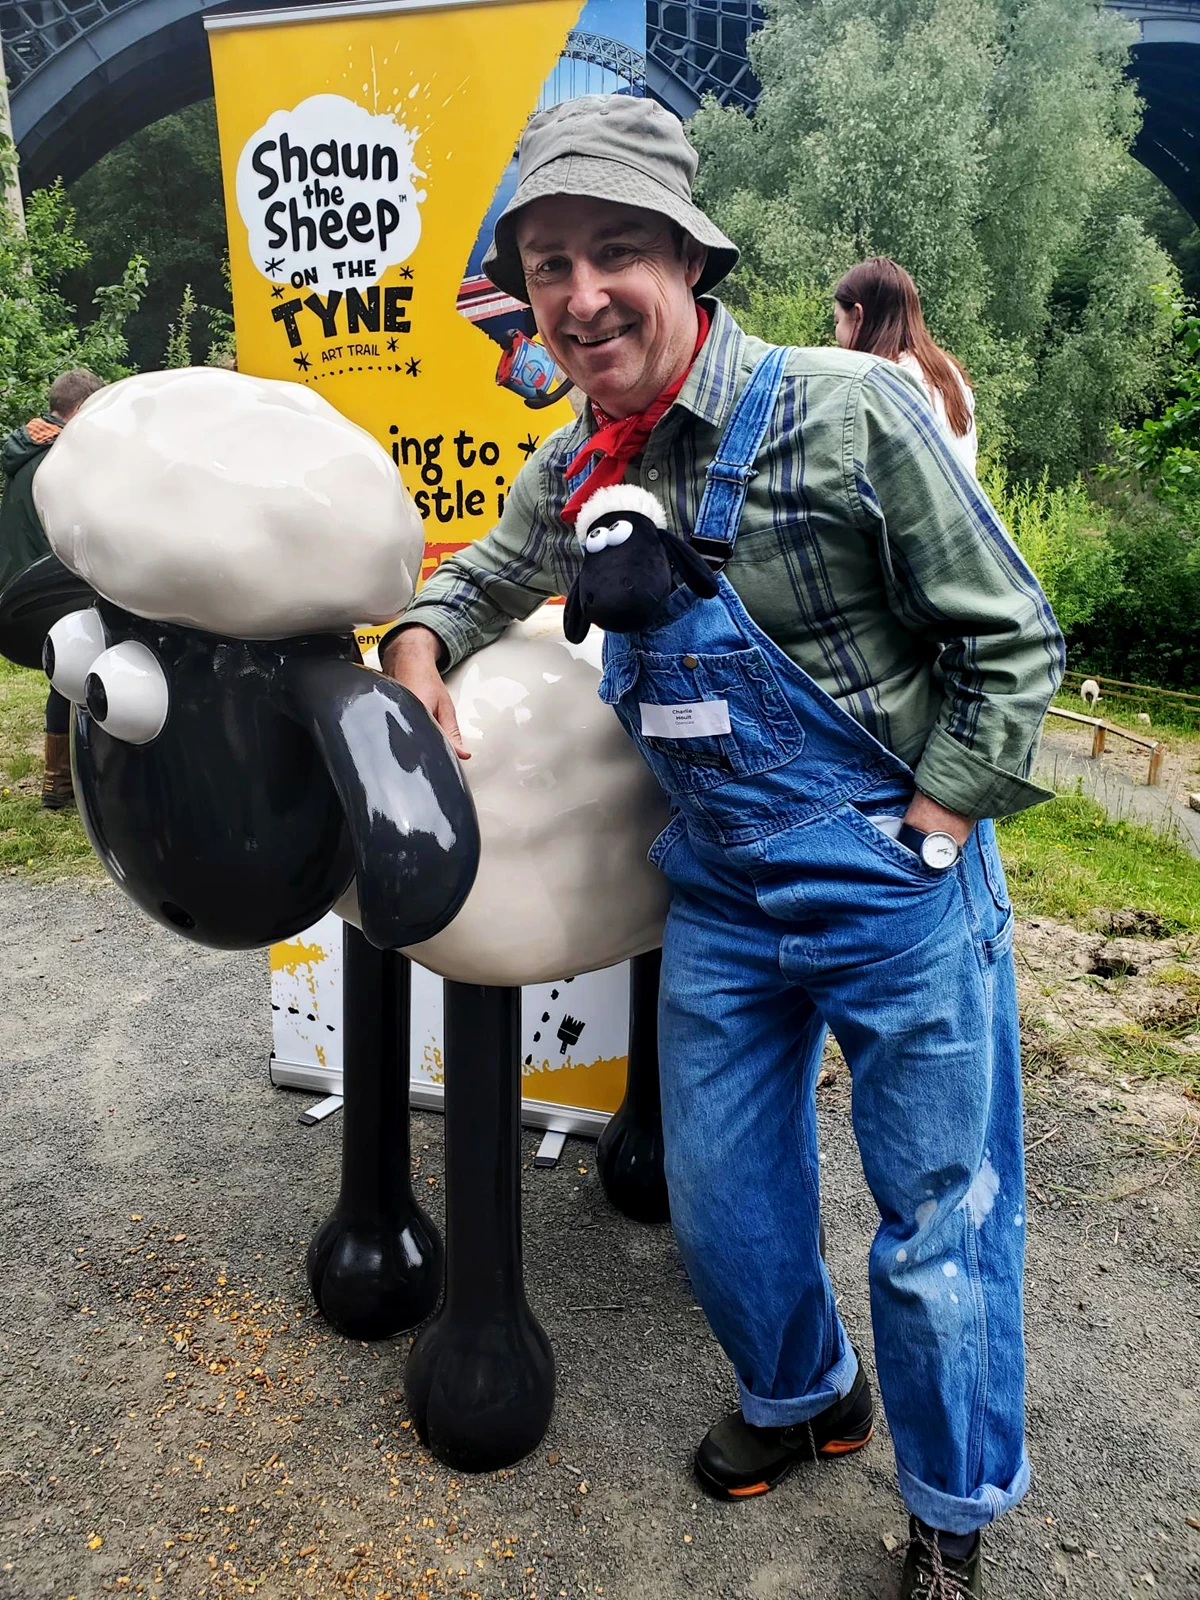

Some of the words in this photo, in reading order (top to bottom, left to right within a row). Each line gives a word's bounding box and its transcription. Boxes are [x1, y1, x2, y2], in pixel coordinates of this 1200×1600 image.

[252, 132, 399, 200] Shaun
[303, 178, 345, 209] the
[264, 197, 400, 252] Sheep
[290, 266, 319, 289] ON
[332, 259, 377, 279] THE
[271, 286, 414, 348] TYNE
[321, 346, 343, 363] ART
[346, 343, 381, 357] TRAIL
[389, 424, 444, 486] ing
[453, 430, 500, 468] to
[407, 479, 485, 523] stle
[495, 476, 511, 519] i
